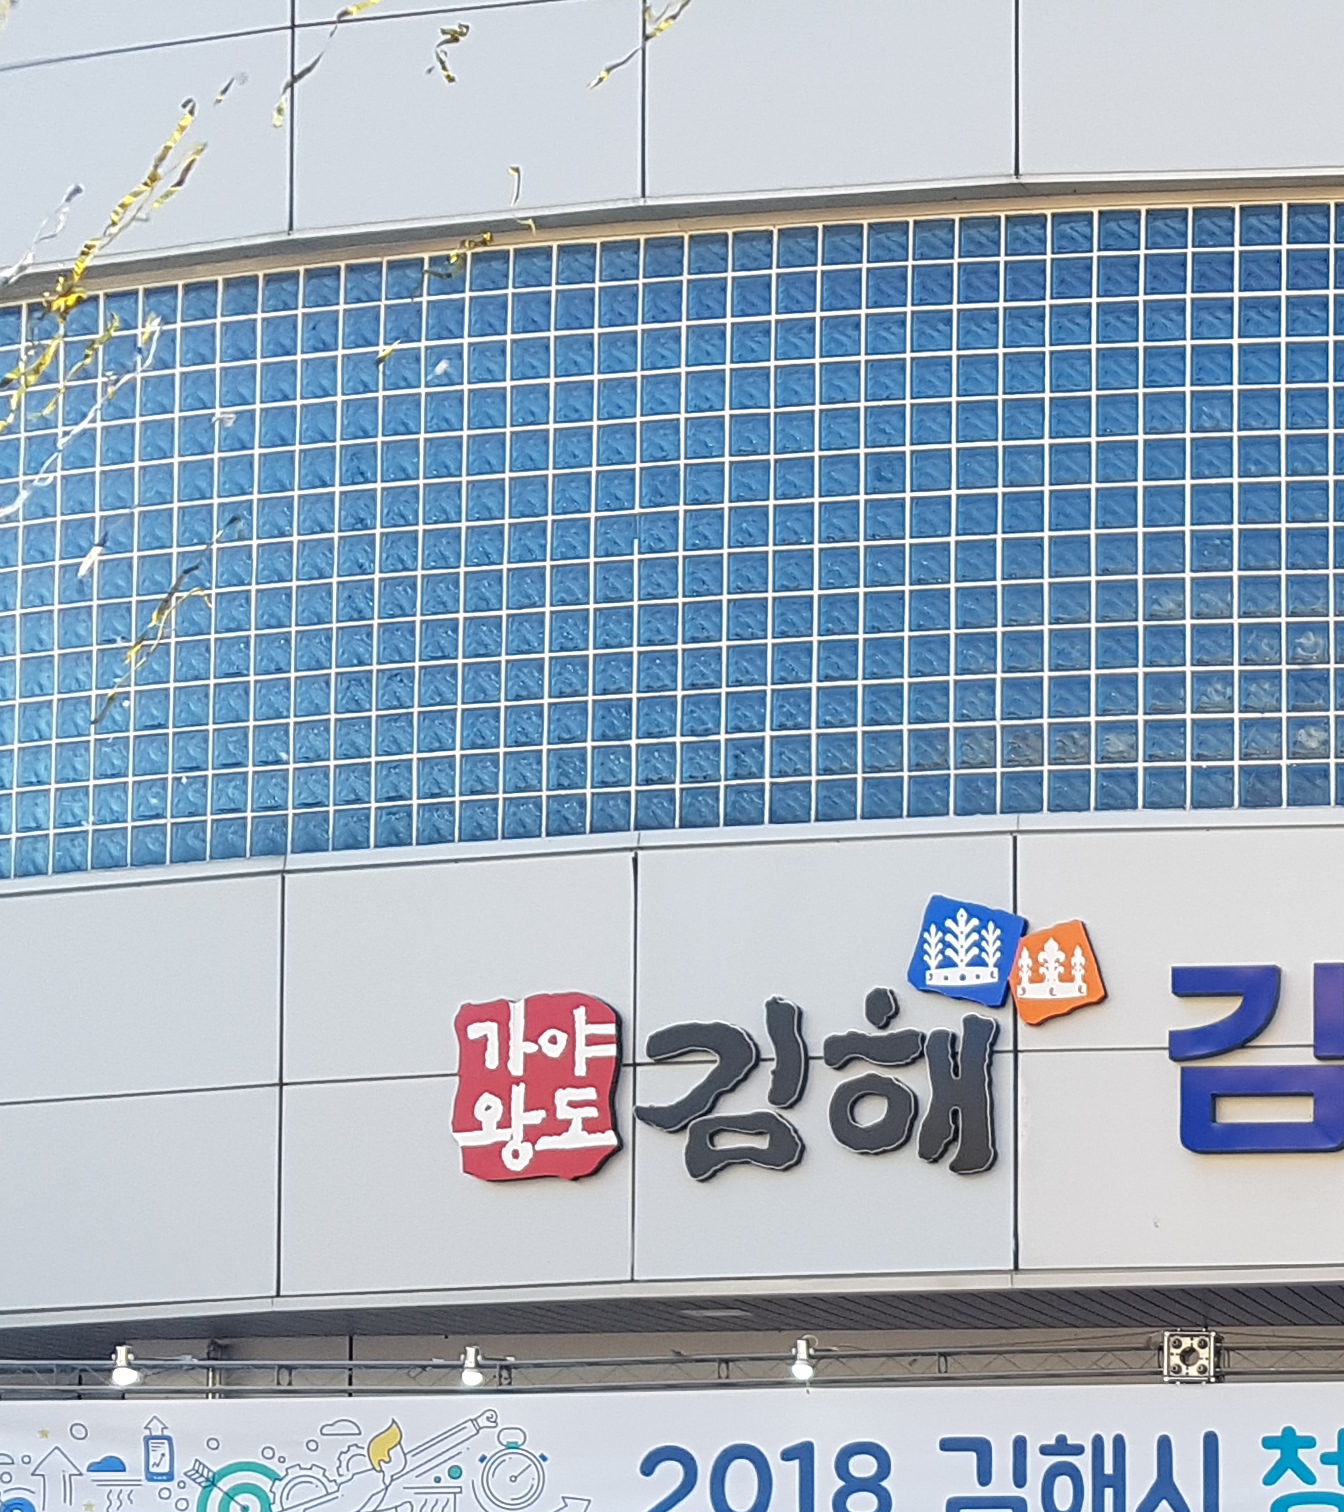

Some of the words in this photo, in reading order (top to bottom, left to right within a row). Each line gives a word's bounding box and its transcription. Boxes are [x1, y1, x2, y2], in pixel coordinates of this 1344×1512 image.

[468, 1002, 616, 1078] 가야
[634, 987, 999, 1181] 김해
[453, 1088, 616, 1172] 왕도
